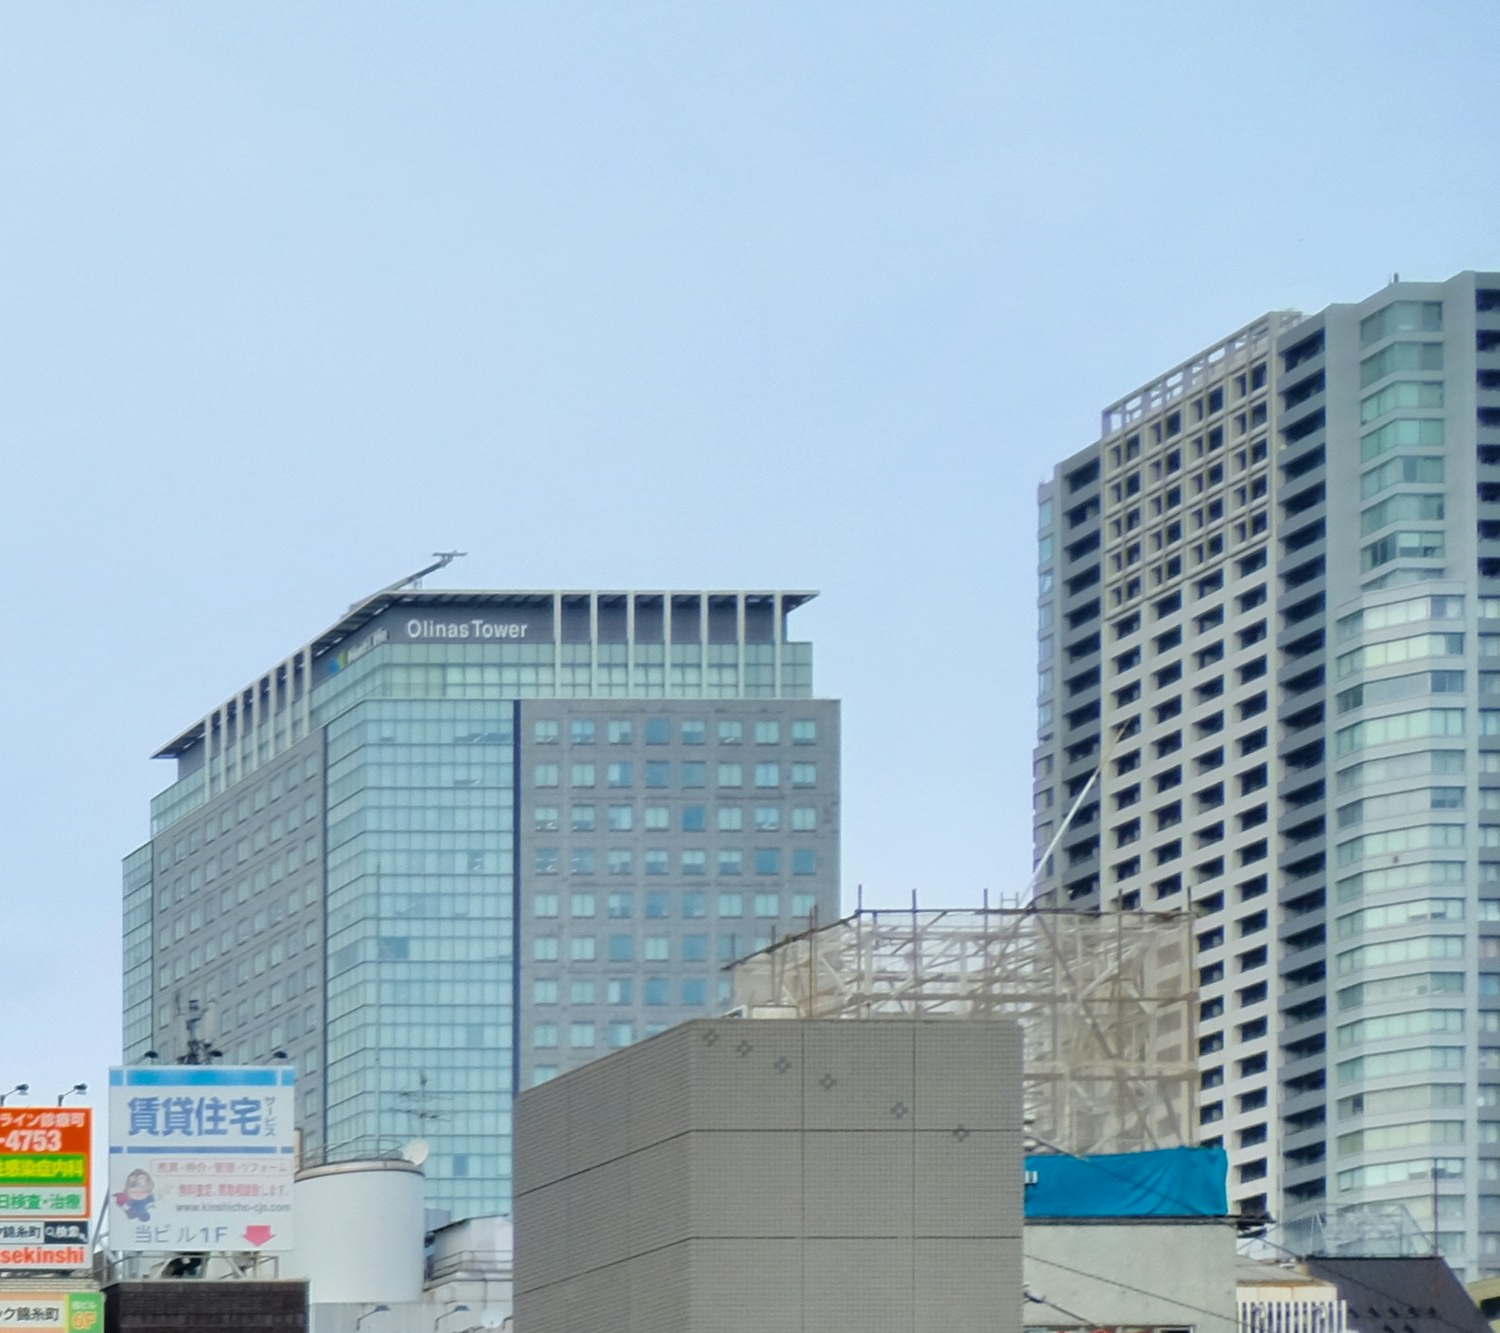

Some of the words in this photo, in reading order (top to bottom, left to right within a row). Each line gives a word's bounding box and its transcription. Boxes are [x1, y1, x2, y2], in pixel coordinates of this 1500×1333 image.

[406, 617, 470, 639] Olinas
[472, 618, 528, 639] Tower
[127, 1096, 262, 1136] 賃貸住宅
[71, 1312, 97, 1331] 6F
